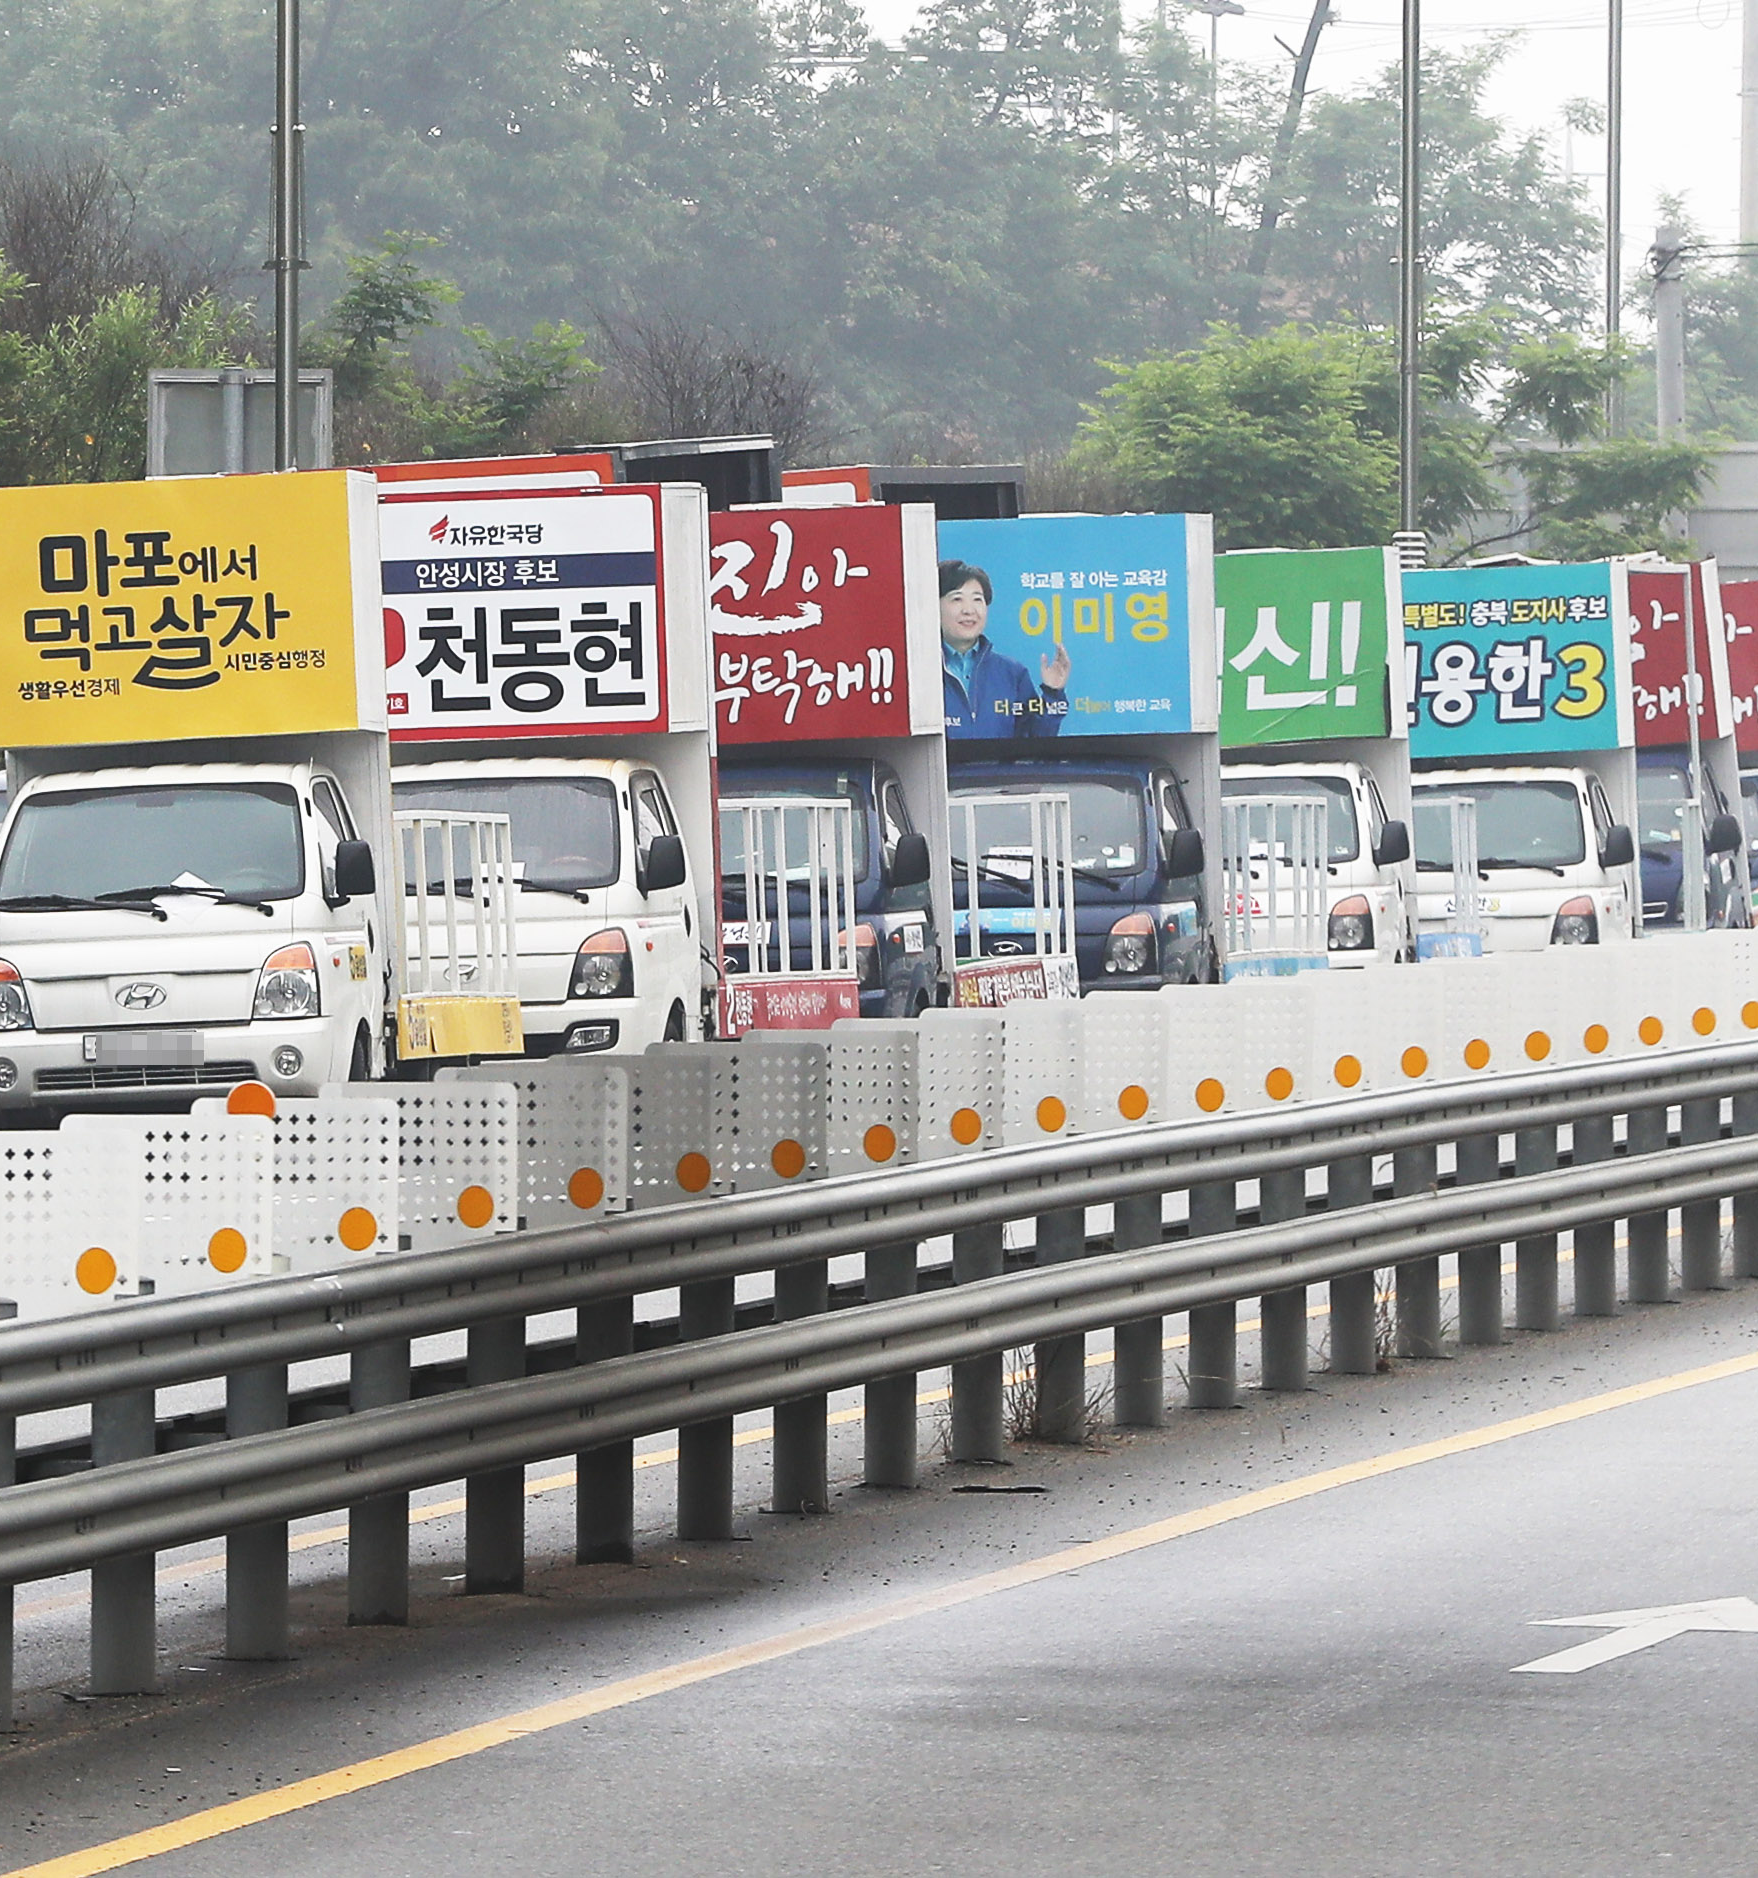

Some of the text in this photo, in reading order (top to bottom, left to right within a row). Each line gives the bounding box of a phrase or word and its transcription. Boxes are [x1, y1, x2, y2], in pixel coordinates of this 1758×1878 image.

[449, 523, 544, 547] 자유한국당
[39, 529, 259, 597] 마포에서
[415, 559, 560, 589] 안성시장 후보
[709, 520, 869, 636] 진아
[1020, 569, 1168, 589] 학교를 잘 아는 교육감
[1019, 591, 1169, 644] 이미영
[1403, 595, 1607, 629] 특별도! 충북 도지사 후보
[415, 601, 646, 713] 천동현
[1215, 601, 1362, 714] 신!
[714, 647, 893, 725] 부탁해!!
[994, 698, 1009, 716] 더
[1028, 698, 1043, 716] 더
[1149, 698, 1172, 712] 교육
